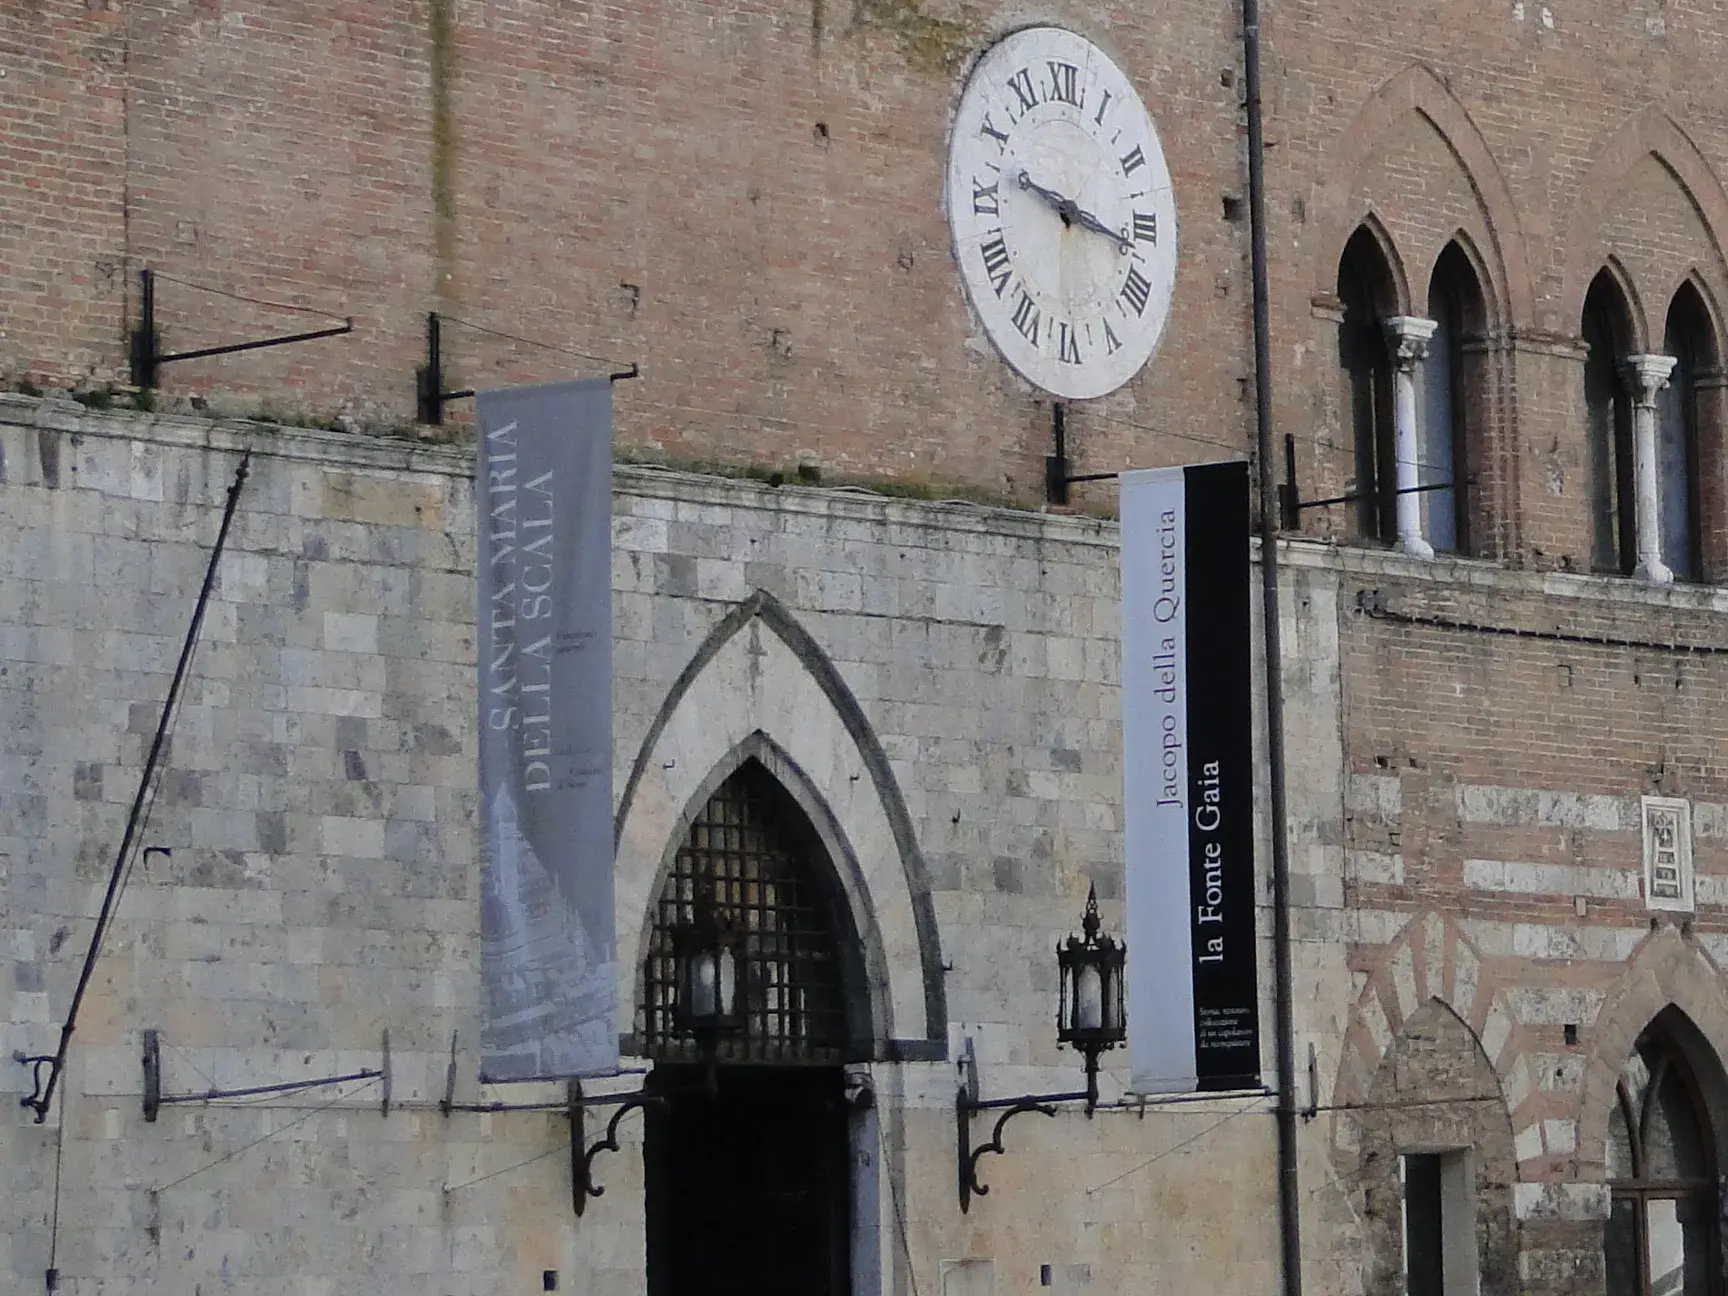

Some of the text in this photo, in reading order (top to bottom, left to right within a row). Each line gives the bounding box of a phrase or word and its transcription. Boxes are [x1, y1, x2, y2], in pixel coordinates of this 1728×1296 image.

[1007, 67, 1039, 119] XI
[1047, 61, 1079, 106] XII
[1120, 143, 1147, 178] II
[972, 175, 1001, 218] IX
[1132, 209, 1157, 248] III
[981, 234, 1012, 300] VIII
[1119, 264, 1152, 319] IIII
[1010, 289, 1042, 348] VII
[1059, 321, 1083, 365] VI
[486, 419, 522, 730] SANTA MARIA
[520, 468, 555, 791] DELLA SCALA
[1152, 509, 1184, 809] Jacopo della Quercia
[1195, 759, 1224, 964] la Fonte Gaia
